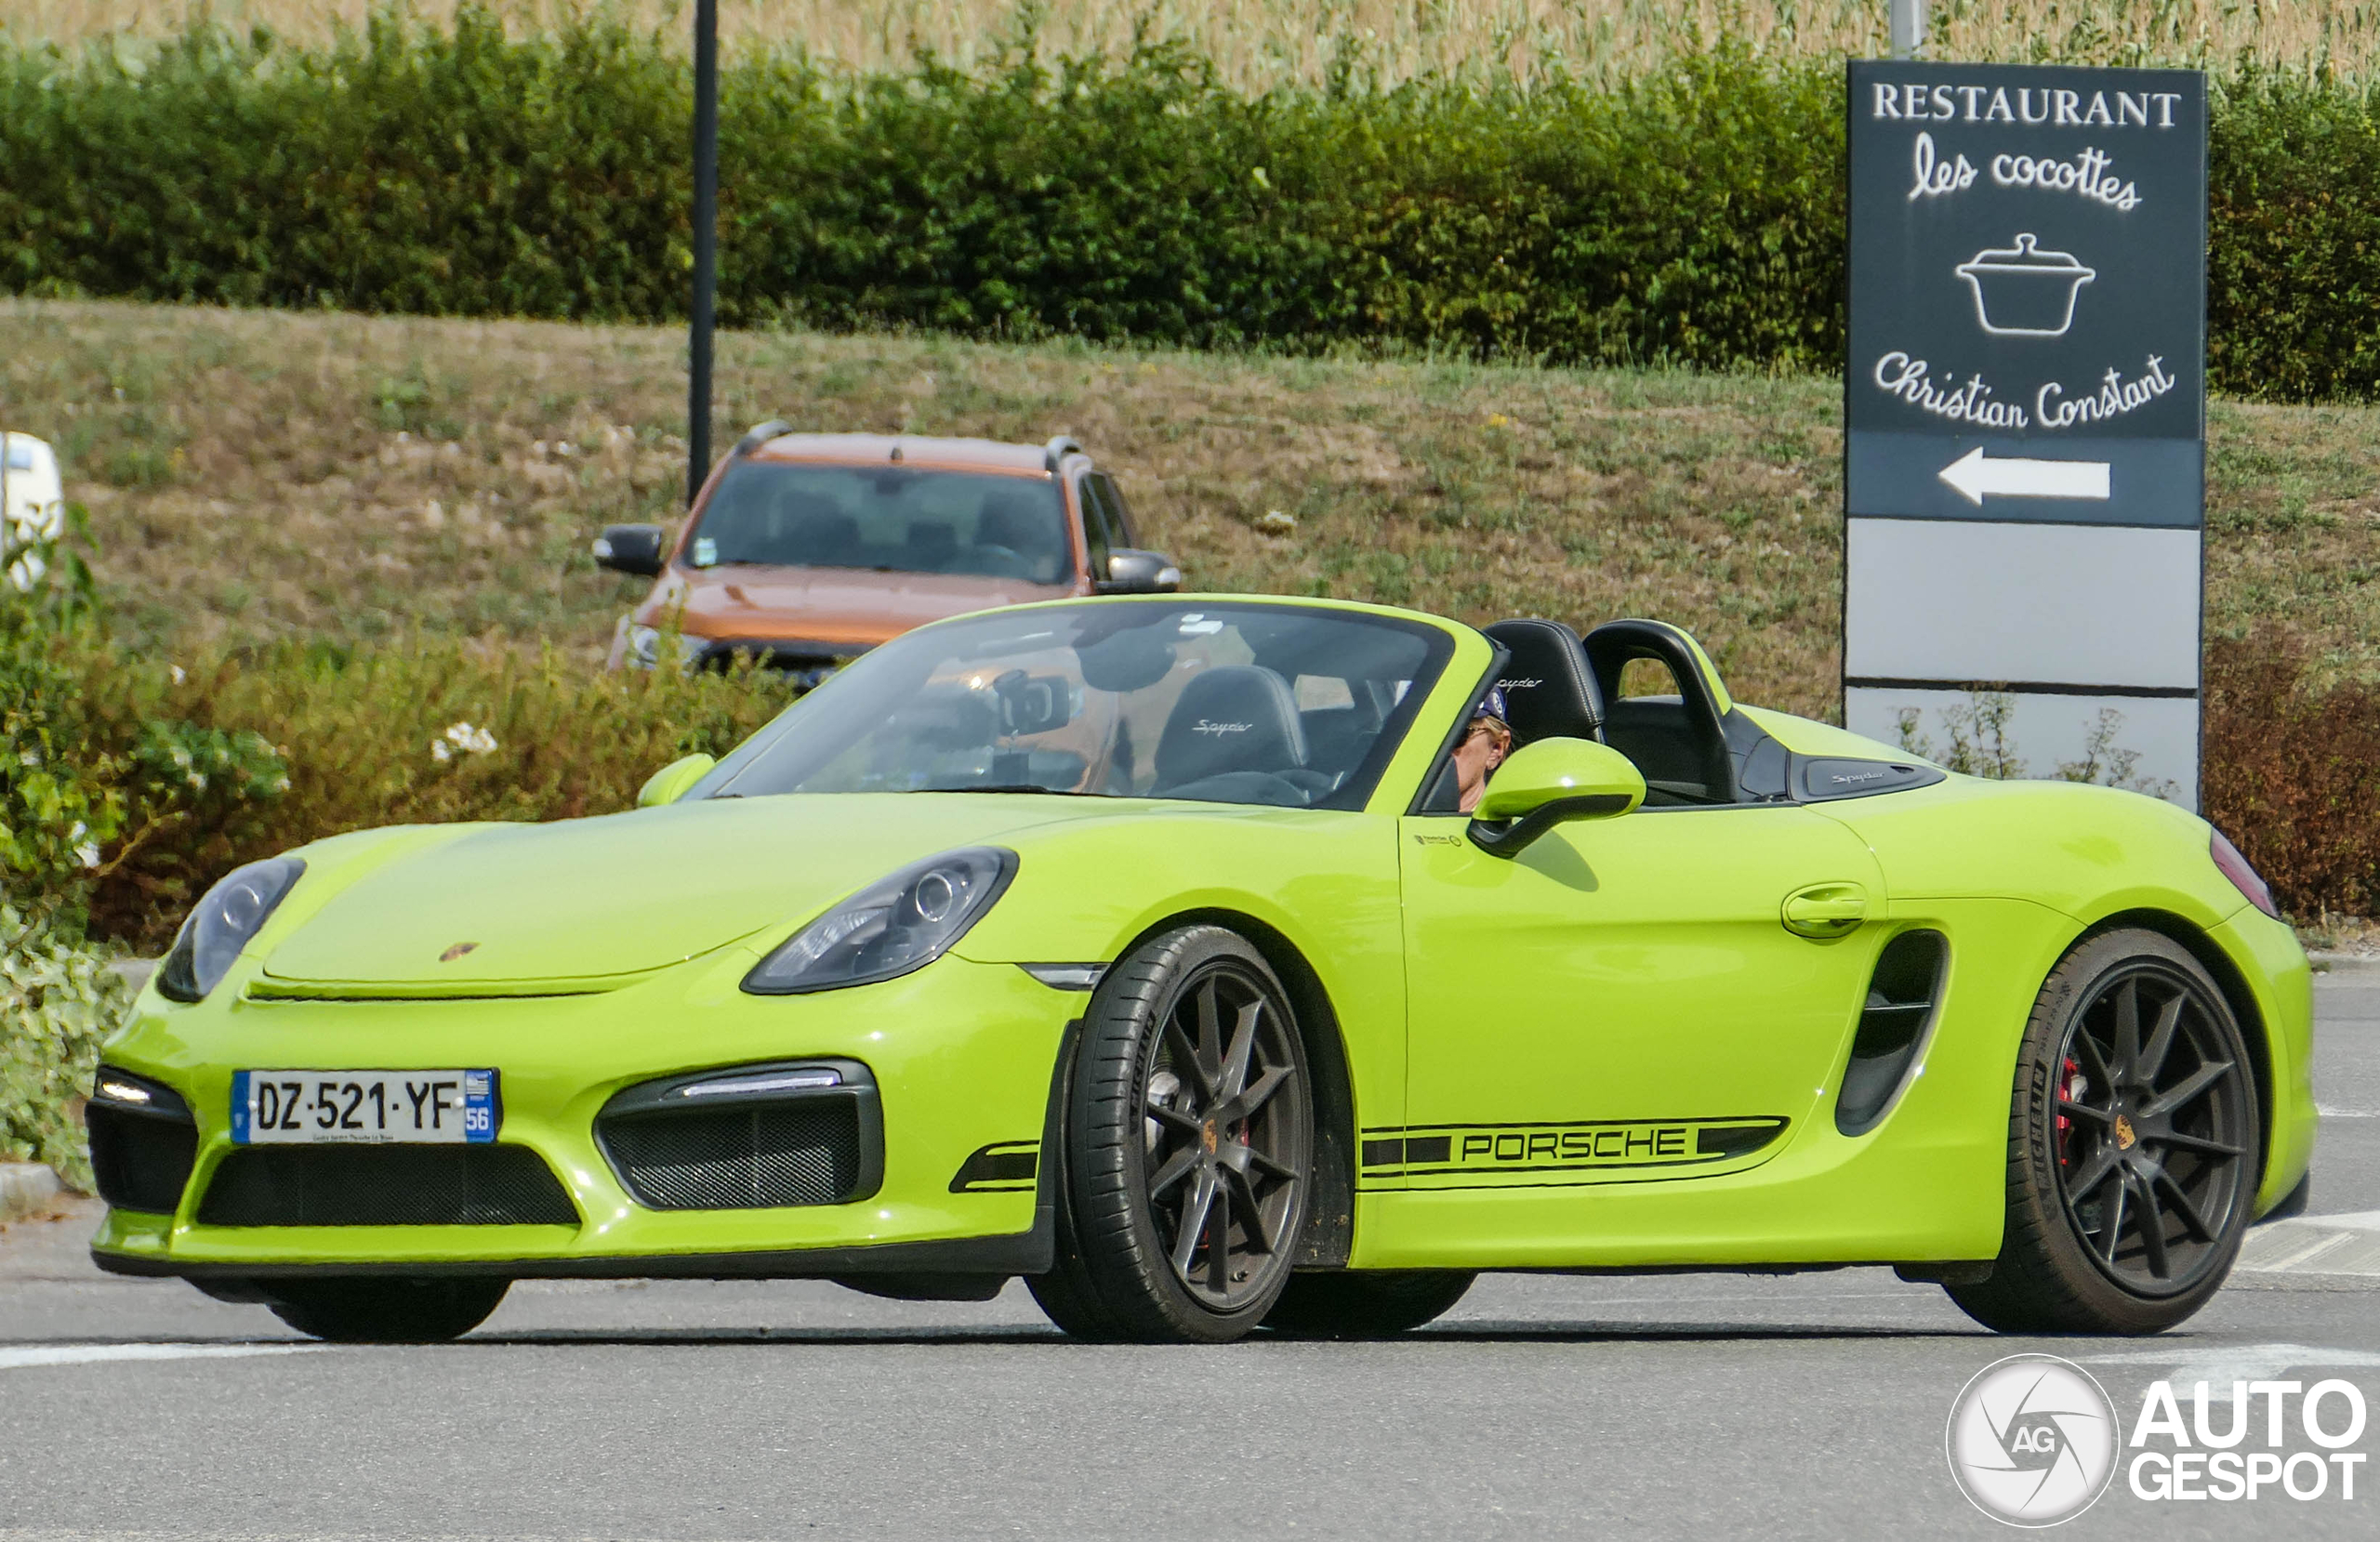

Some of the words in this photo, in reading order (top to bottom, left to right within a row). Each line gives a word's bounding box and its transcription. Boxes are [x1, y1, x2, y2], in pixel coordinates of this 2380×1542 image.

[1872, 82, 2183, 127] RESTAURANT
[1908, 131, 1978, 200] les
[1992, 146, 2143, 211] cocottes
[1874, 350, 2030, 428] Christian
[2037, 354, 2176, 428] Constant
[1192, 718, 1254, 738] Spyder
[1831, 771, 1885, 784] Spyder
[465, 1106, 489, 1131] 56
[2030, 1064, 2051, 1192] MICHELIN
[1461, 1127, 1687, 1163] PORSCHE
